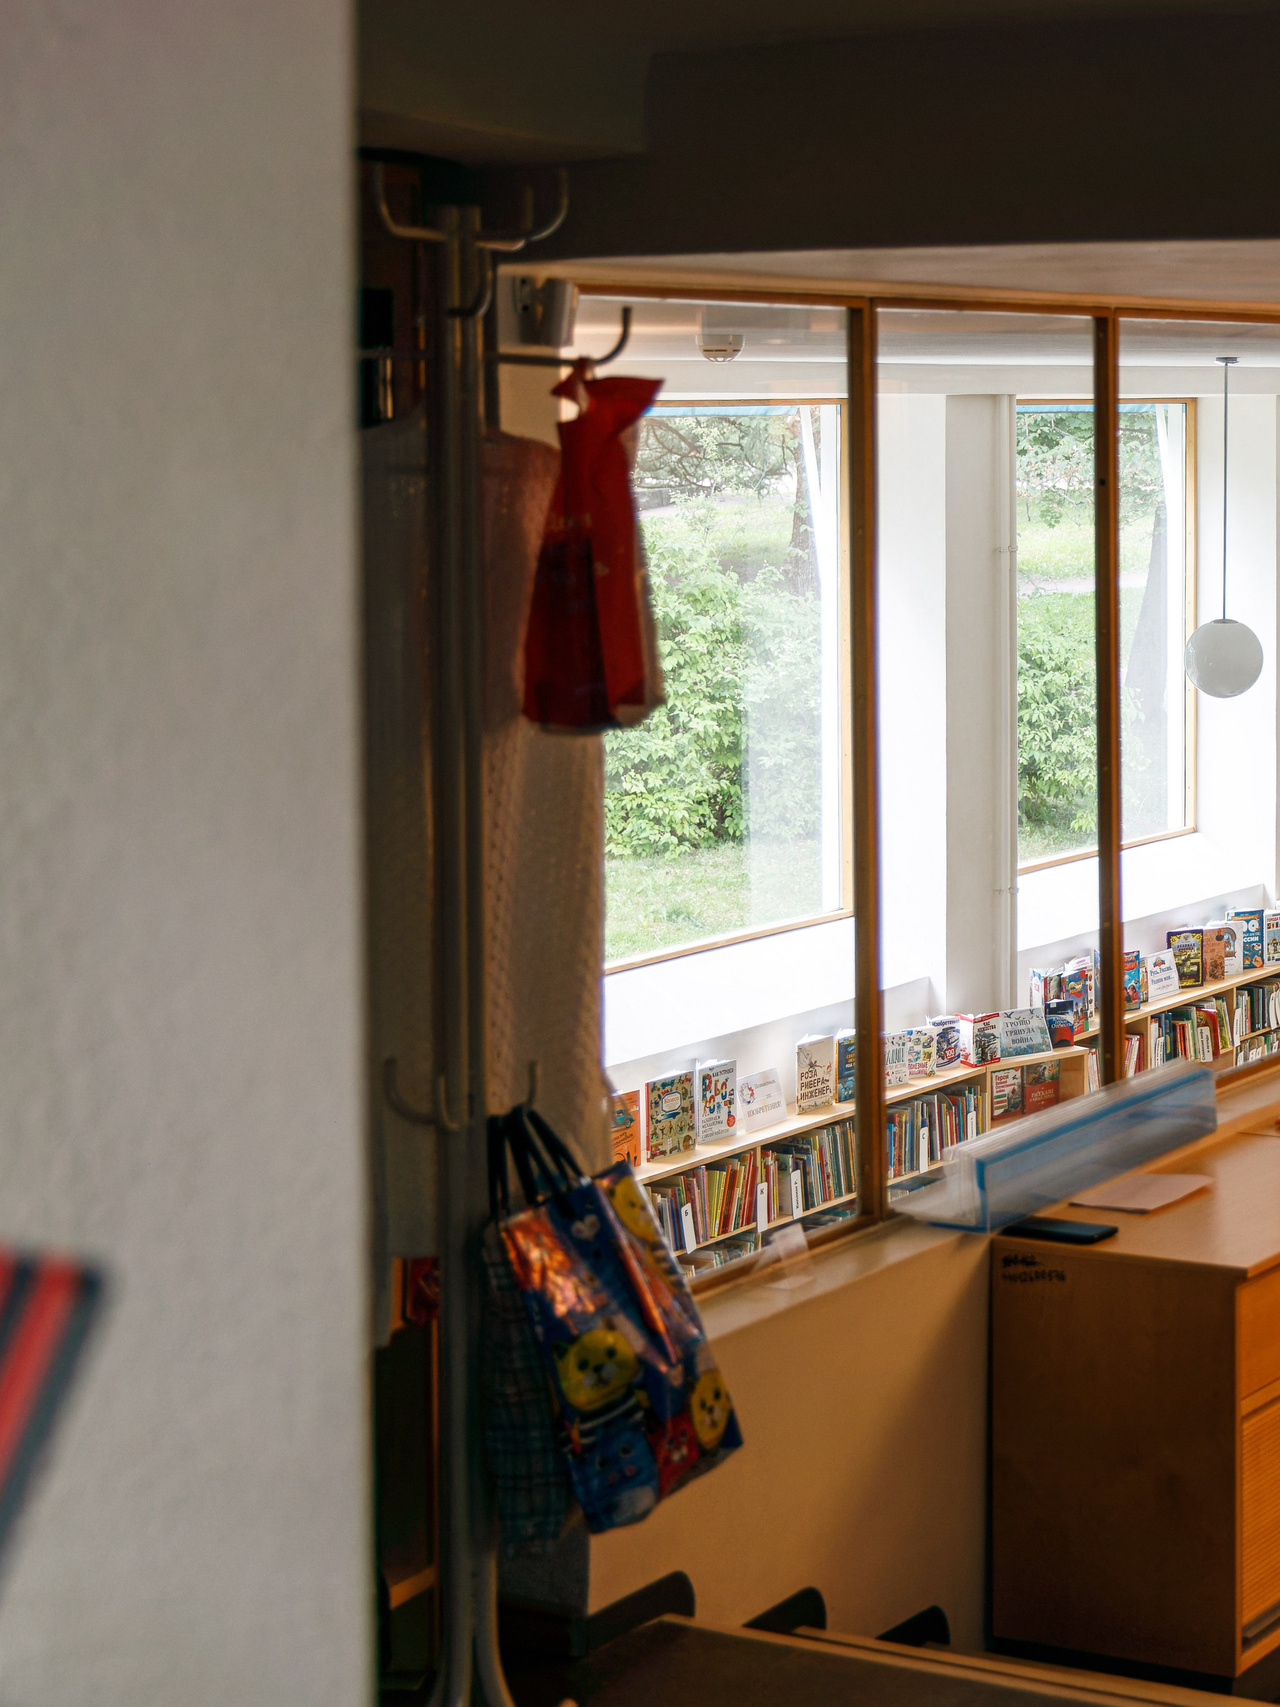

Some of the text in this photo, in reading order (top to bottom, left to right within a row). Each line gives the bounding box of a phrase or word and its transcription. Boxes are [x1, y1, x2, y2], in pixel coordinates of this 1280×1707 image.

[1006, 1027, 1036, 1036] ГРЯНУЛА
[1011, 1036, 1034, 1045] ВОЙНА
[800, 1069, 818, 1081] РОЗА
